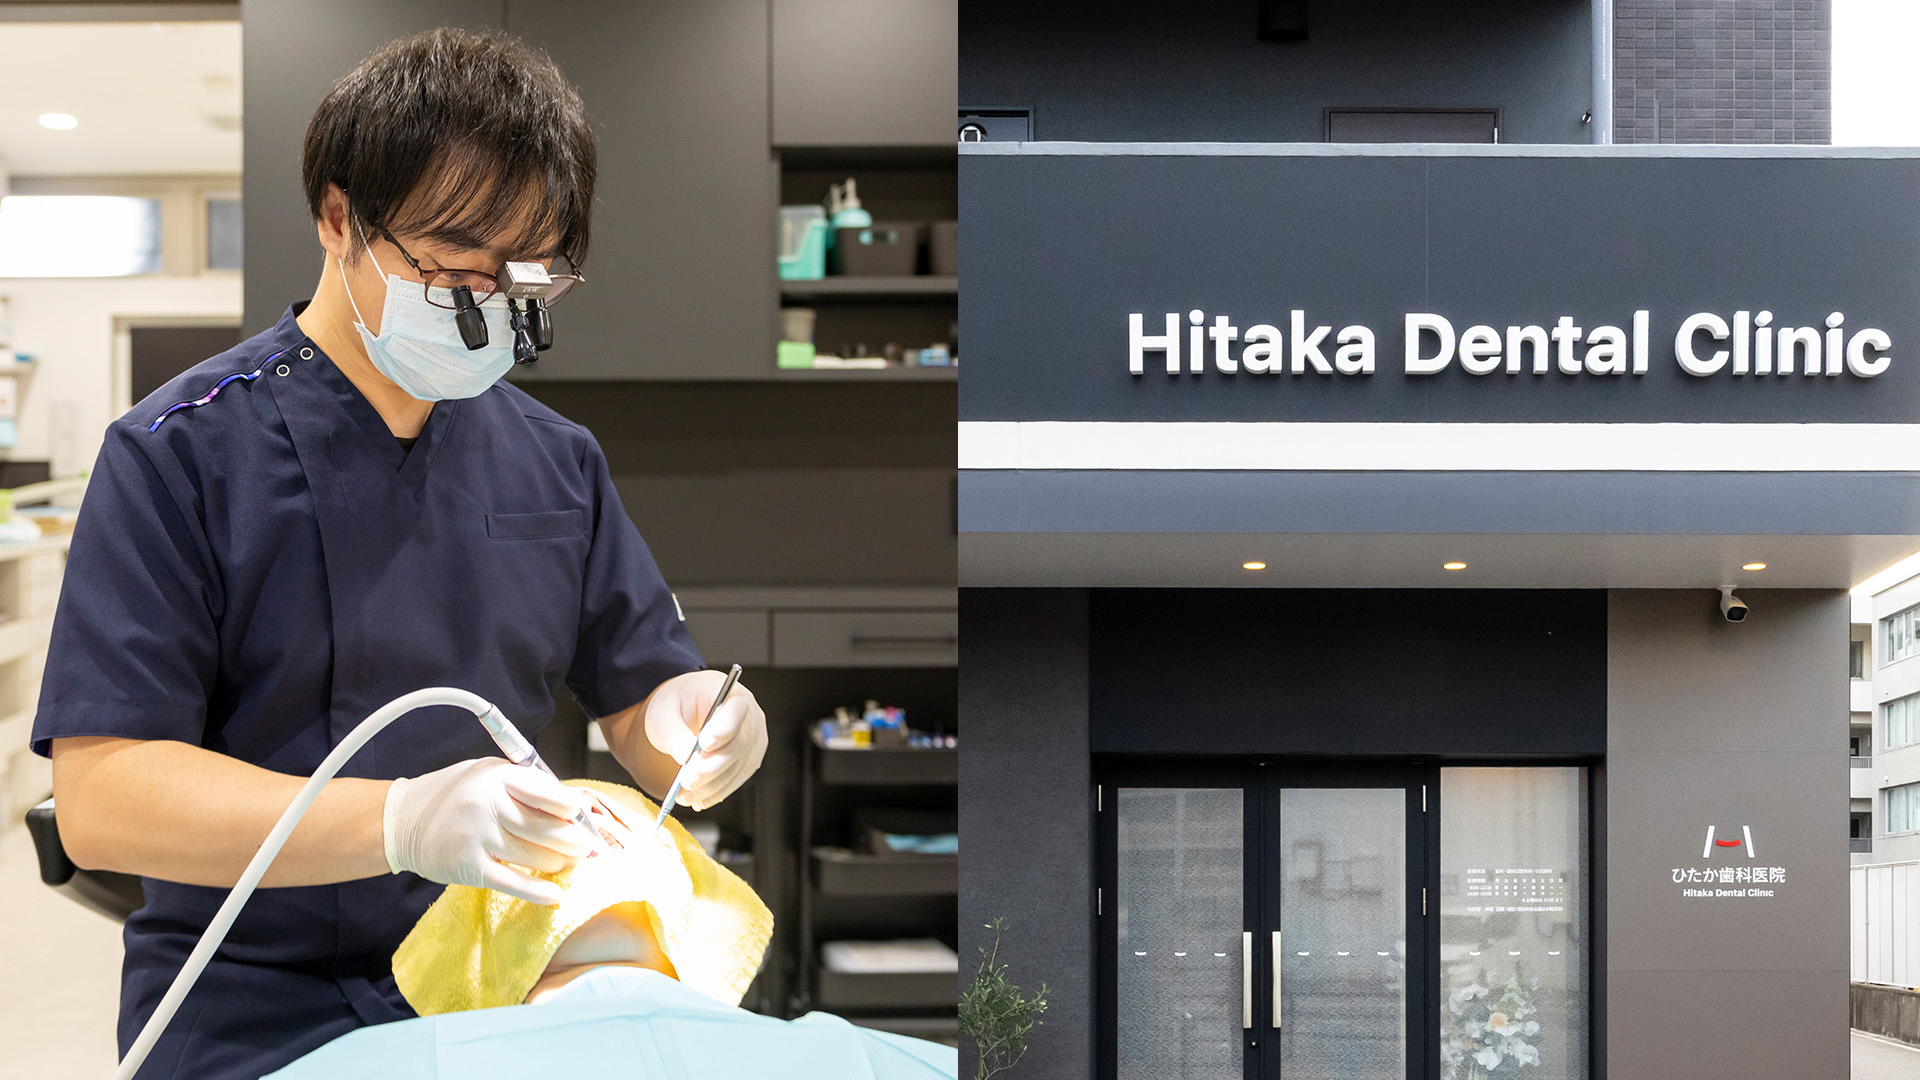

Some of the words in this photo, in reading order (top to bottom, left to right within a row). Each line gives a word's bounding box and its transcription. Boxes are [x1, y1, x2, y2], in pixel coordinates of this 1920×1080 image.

[1129, 309, 1376, 375] Hitaka
[1404, 309, 1650, 375] Dental
[1674, 310, 1892, 378] Clinic
[1671, 866, 1786, 883] ひたか歯科医院
[1683, 888, 1714, 897] Hitaka
[1716, 888, 1746, 897] Dental
[1748, 888, 1774, 897] Clinic
